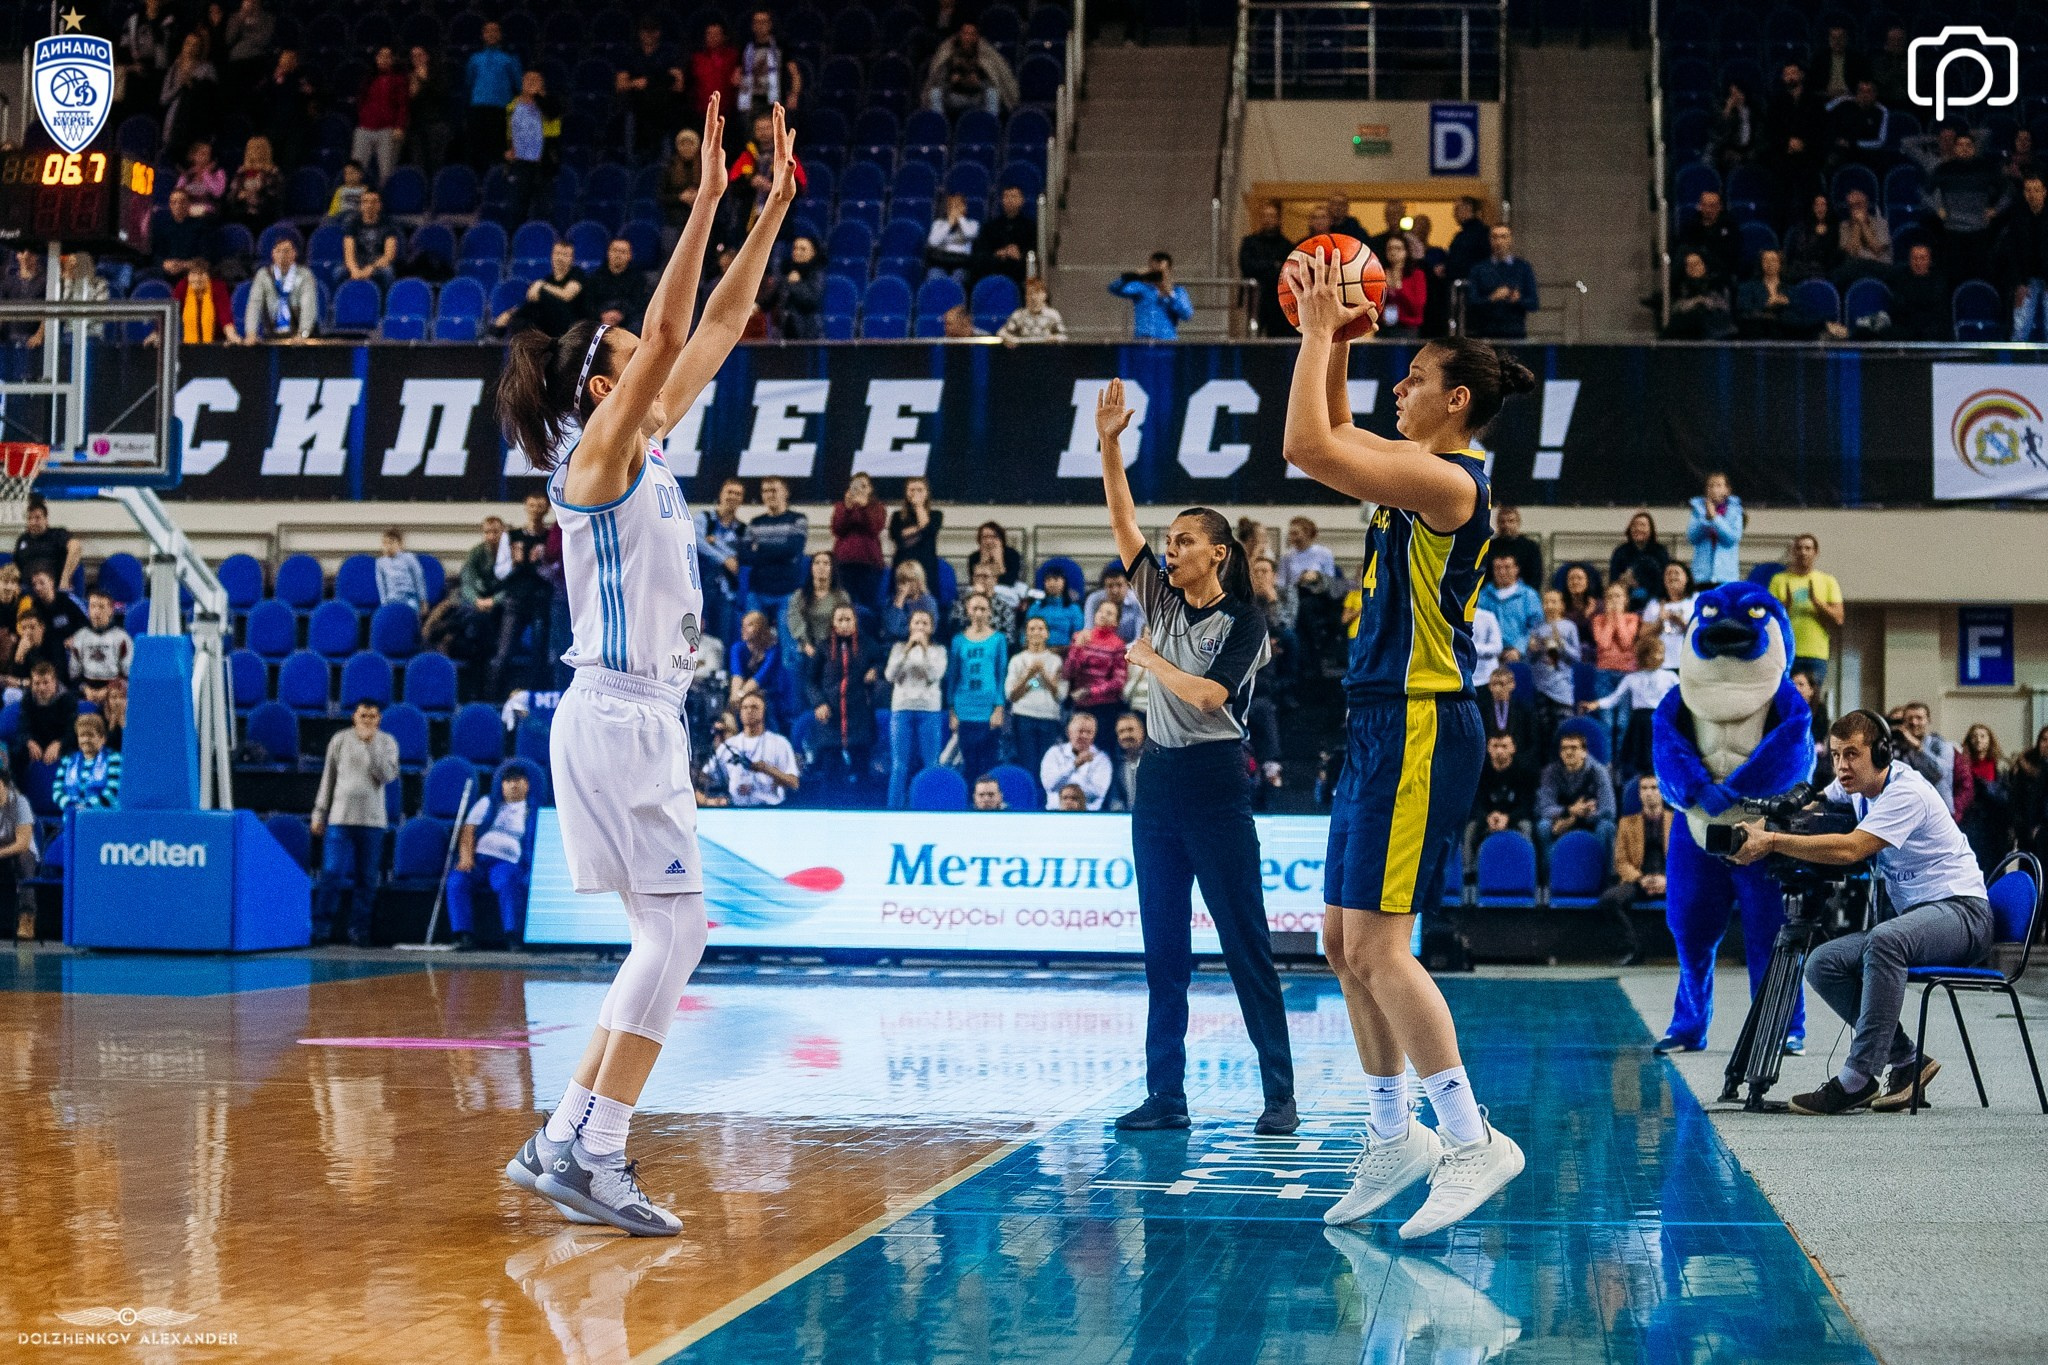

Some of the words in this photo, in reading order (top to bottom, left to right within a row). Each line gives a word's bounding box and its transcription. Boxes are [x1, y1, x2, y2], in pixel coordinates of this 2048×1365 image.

[1434, 122, 1475, 170] D
[173, 378, 944, 478] СИЛЕЕ
[1967, 626, 2004, 679] F
[100, 840, 206, 867] molten
[885, 843, 1324, 890] Металлоес
[881, 902, 1004, 929] Ресурсы
[1016, 908, 1137, 930] создают
